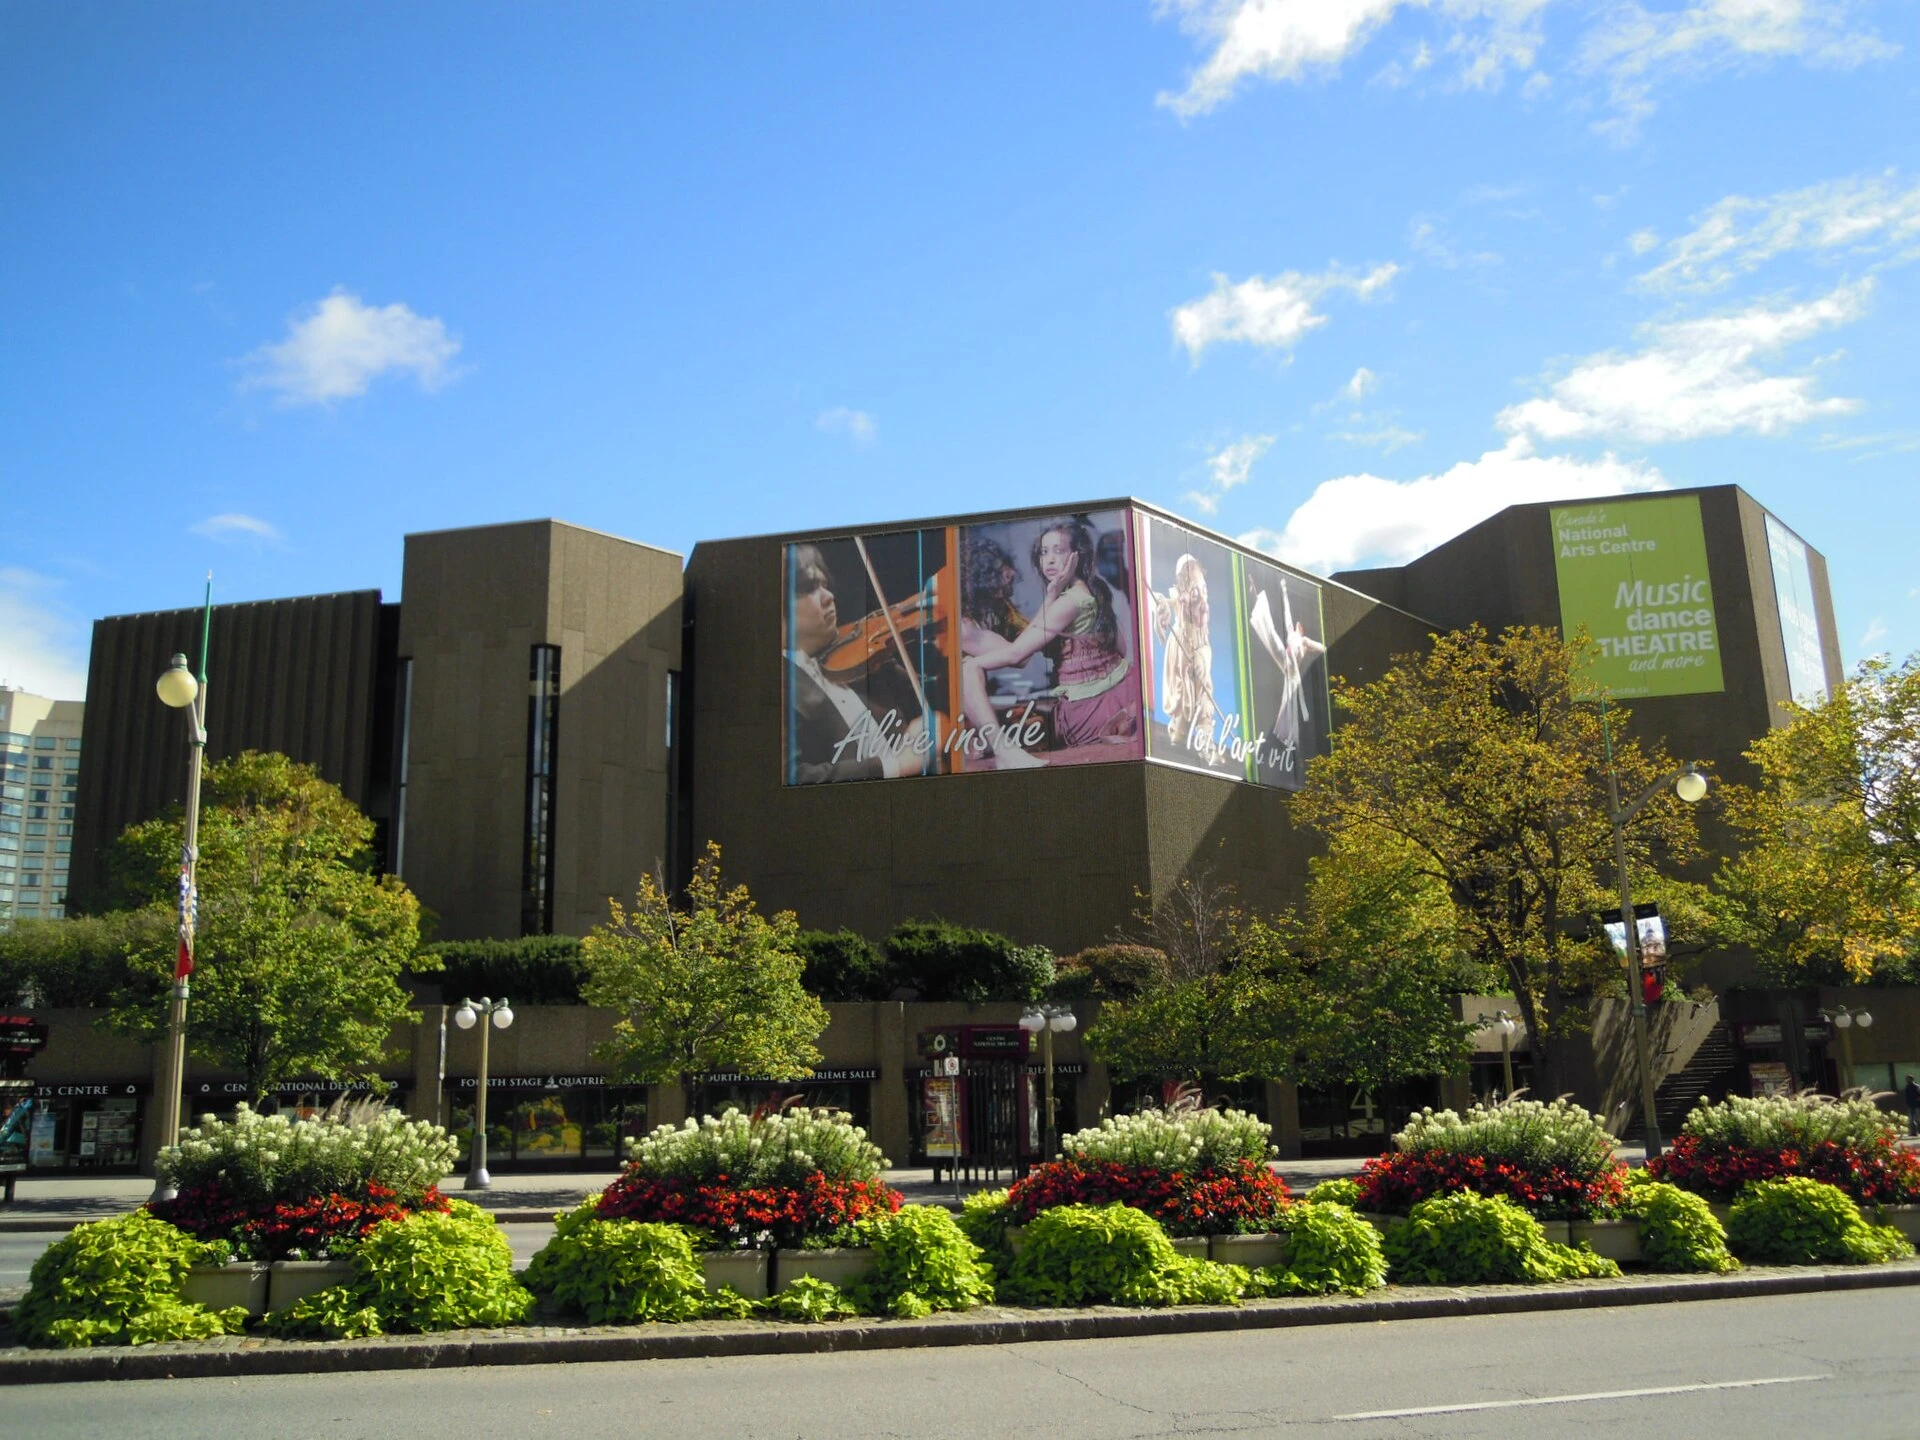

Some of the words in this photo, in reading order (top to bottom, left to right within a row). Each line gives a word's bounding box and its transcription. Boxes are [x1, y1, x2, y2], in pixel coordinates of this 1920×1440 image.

[1558, 524, 1628, 542] National
[1560, 544, 1597, 559] Arts
[1600, 539, 1657, 554] Centre
[1614, 574, 1706, 609] Music
[1626, 608, 1712, 632] dance
[1596, 630, 1715, 657] THEATRE
[1629, 651, 1660, 672] and
[1661, 655, 1705, 670] more
[831, 708, 934, 764] Alive
[944, 700, 1045, 754] inside
[1218, 713, 1266, 765] l'art
[1268, 734, 1297, 772] vit
[849, 1070, 877, 1079] SALLE
[1057, 1064, 1082, 1073] SALLE
[58, 1085, 109, 1095] CENTRE
[509, 1078, 542, 1087] STAGE
